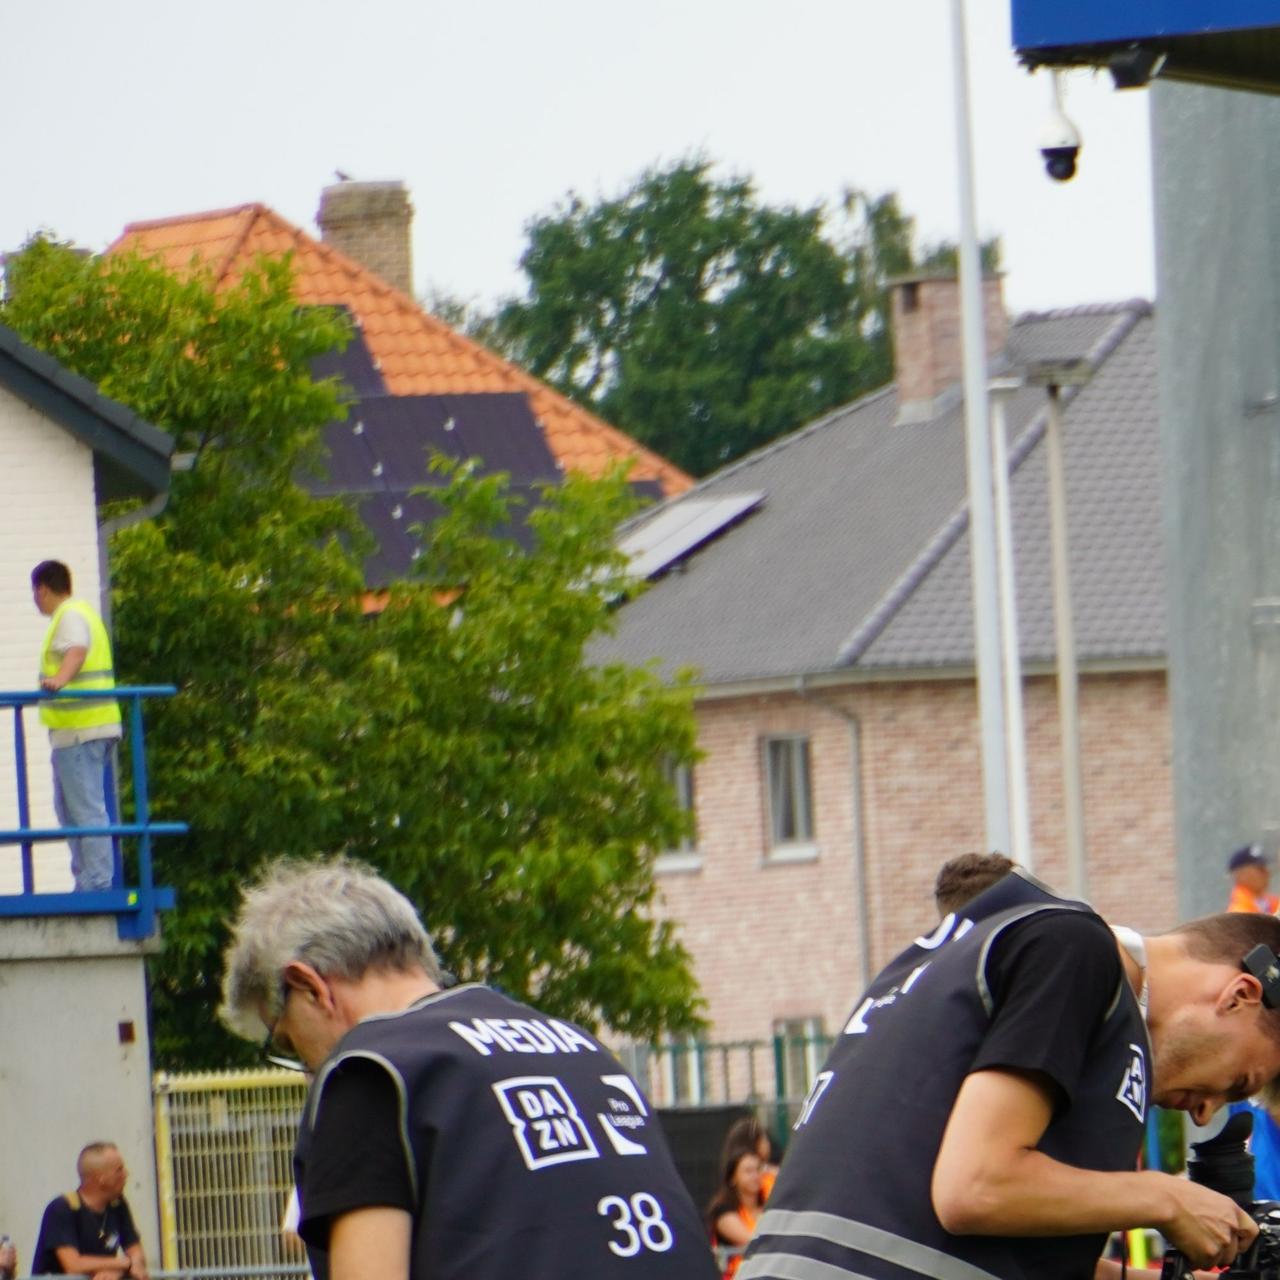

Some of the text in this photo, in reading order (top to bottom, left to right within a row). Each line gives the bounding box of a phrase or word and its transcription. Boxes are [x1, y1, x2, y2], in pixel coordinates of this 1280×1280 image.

[448, 1018, 598, 1055] MEDIA
[517, 1089, 565, 1118] DA
[608, 1098, 629, 1112] Pro
[532, 1118, 578, 1150] ZN
[610, 1113, 645, 1129] League
[597, 1192, 673, 1257] 38
